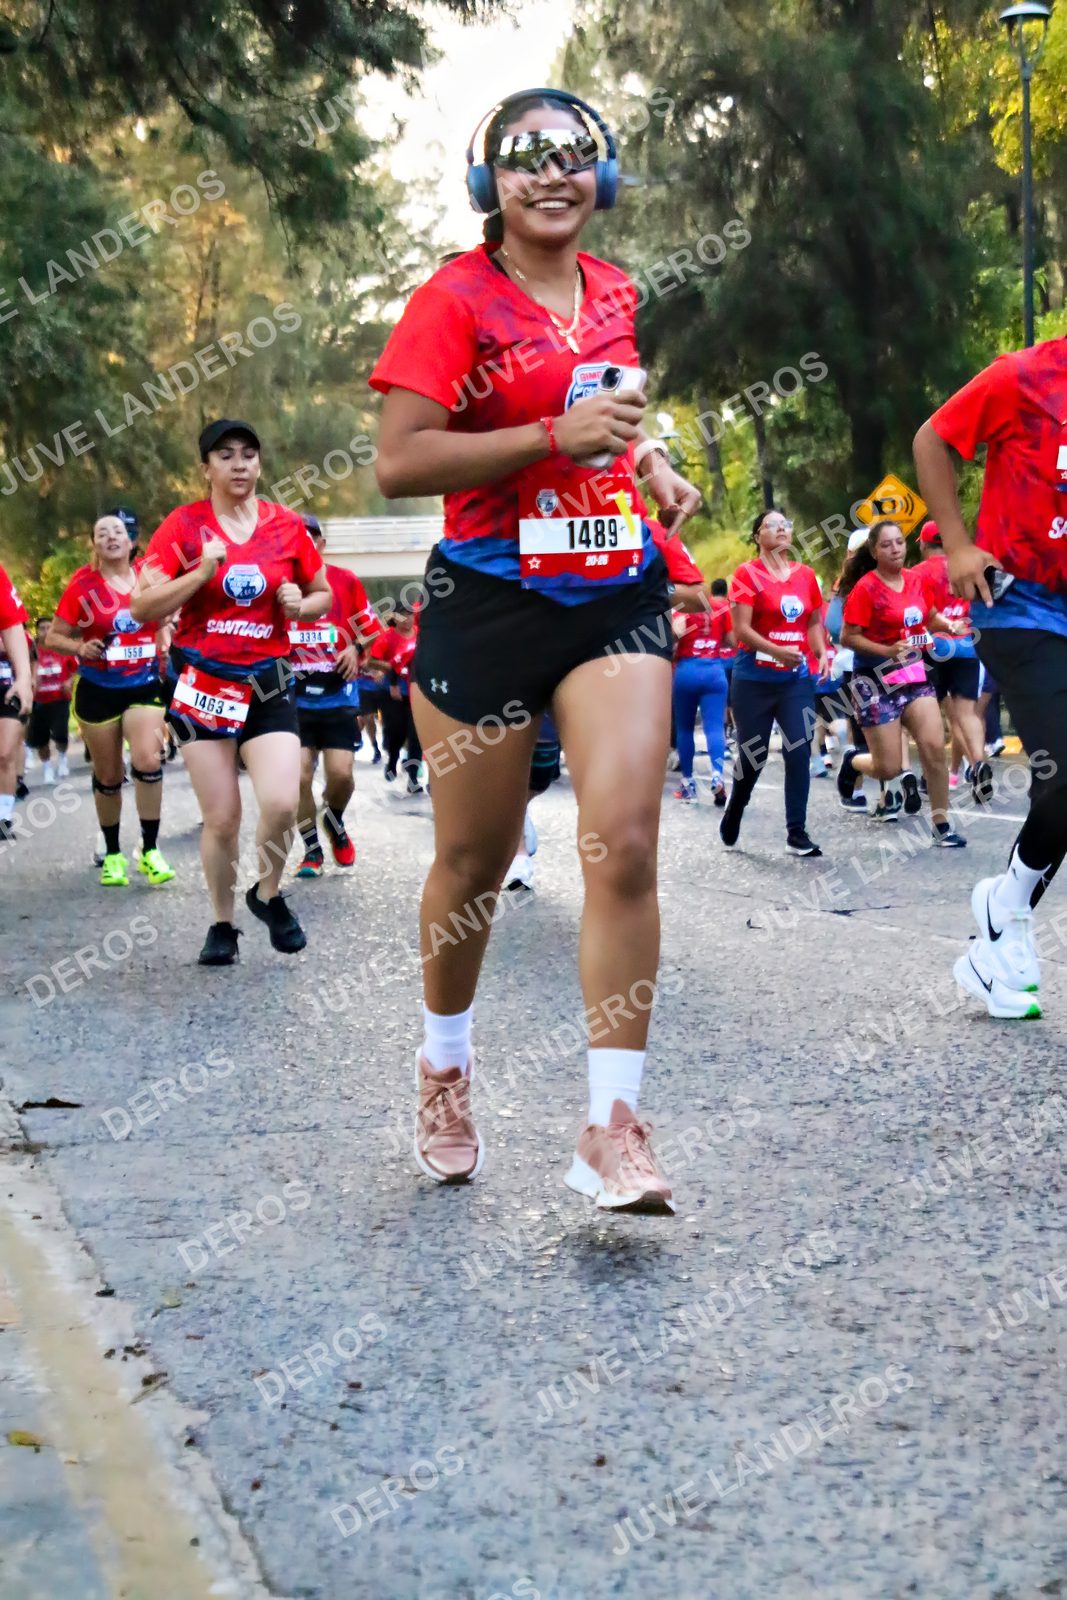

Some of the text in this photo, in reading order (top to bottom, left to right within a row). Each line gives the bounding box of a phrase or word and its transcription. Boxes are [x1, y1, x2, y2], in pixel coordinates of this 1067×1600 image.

[566, 518, 619, 550] 1489
[206, 618, 274, 640] SANTIAGO
[299, 631, 323, 643] 3334
[123, 646, 143, 658] 1558
[193, 691, 226, 716] 1463
